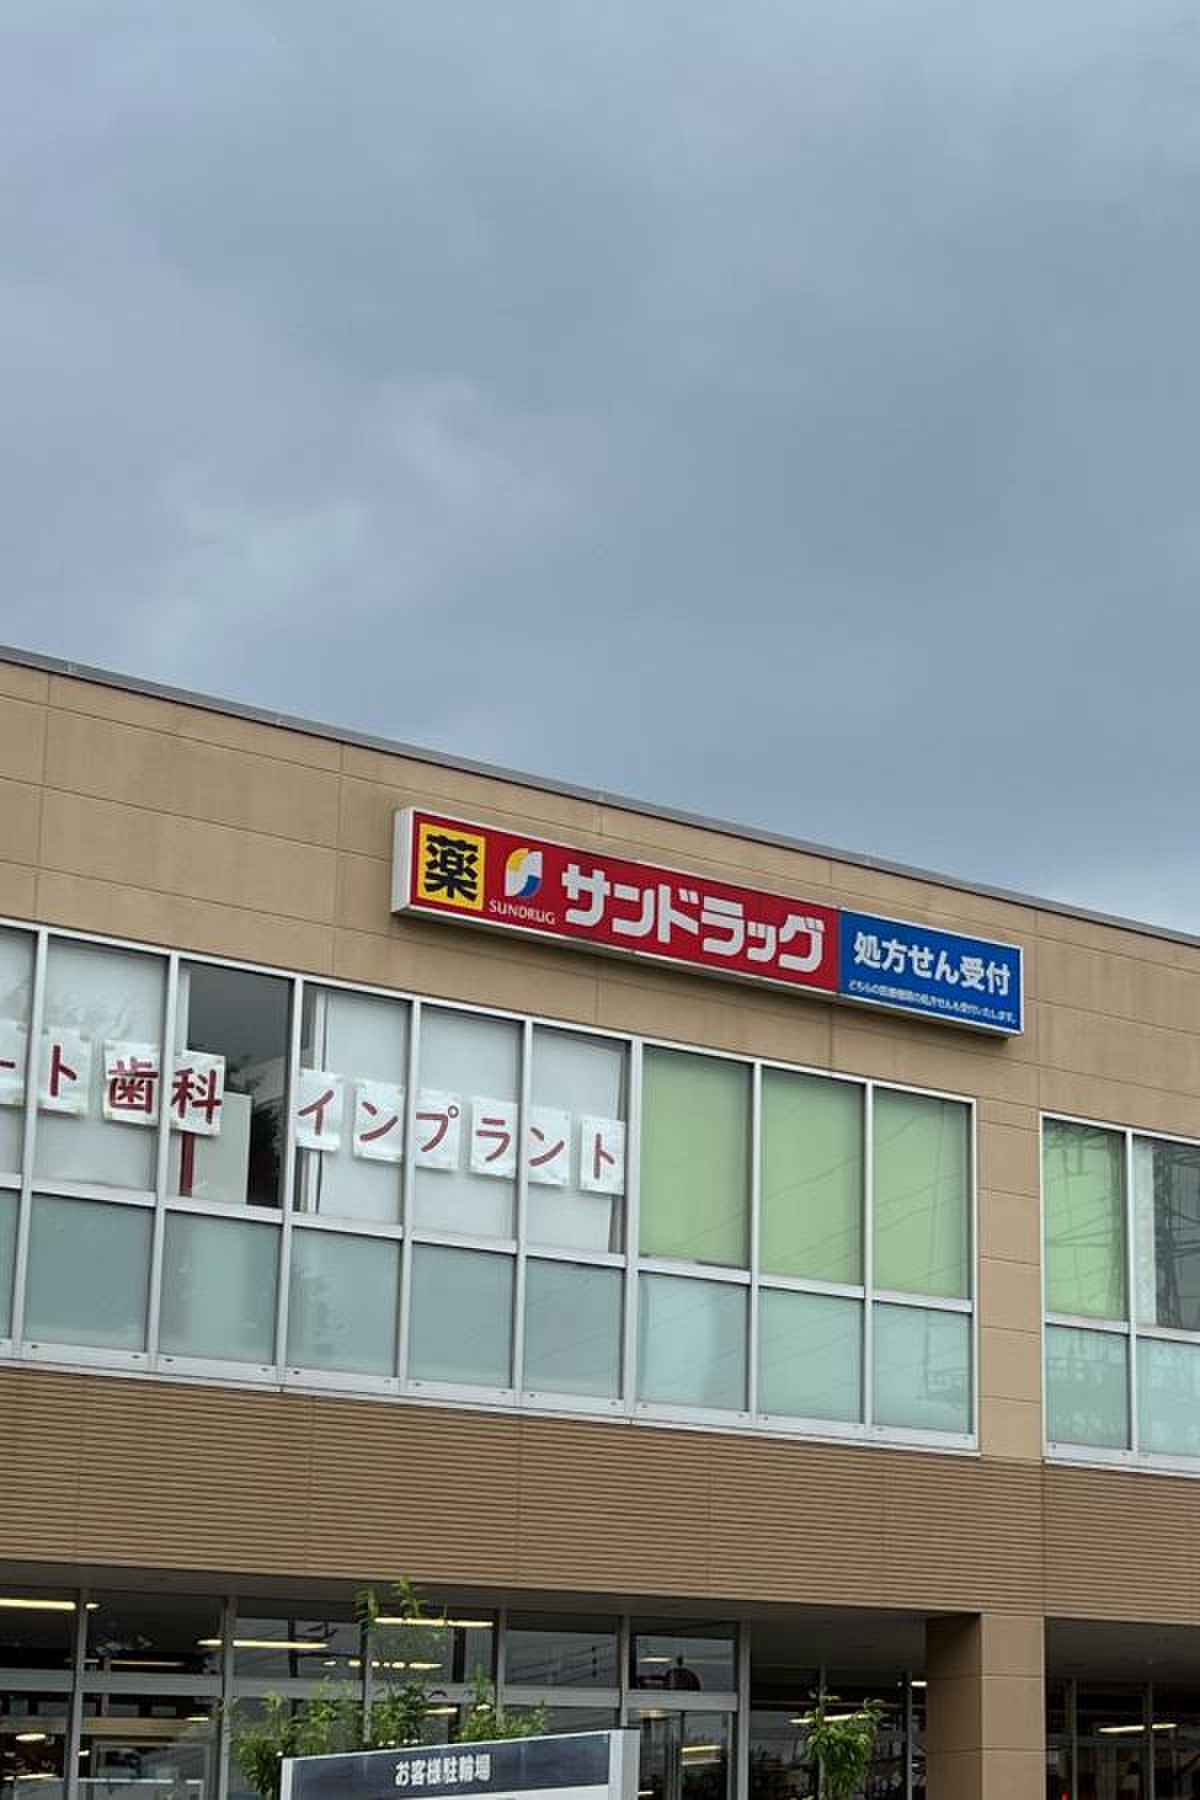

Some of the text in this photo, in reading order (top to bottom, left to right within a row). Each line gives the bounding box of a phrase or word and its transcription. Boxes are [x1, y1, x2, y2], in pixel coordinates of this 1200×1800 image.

[424, 833, 478, 902] 薬
[489, 899, 555, 926] SUNDRUG
[561, 863, 825, 973] サンドラッグ
[854, 931, 1011, 997] 処方せん受付
[298, 1089, 615, 1180] インプラント
[395, 1754, 490, 1786] お客様駐輪場
